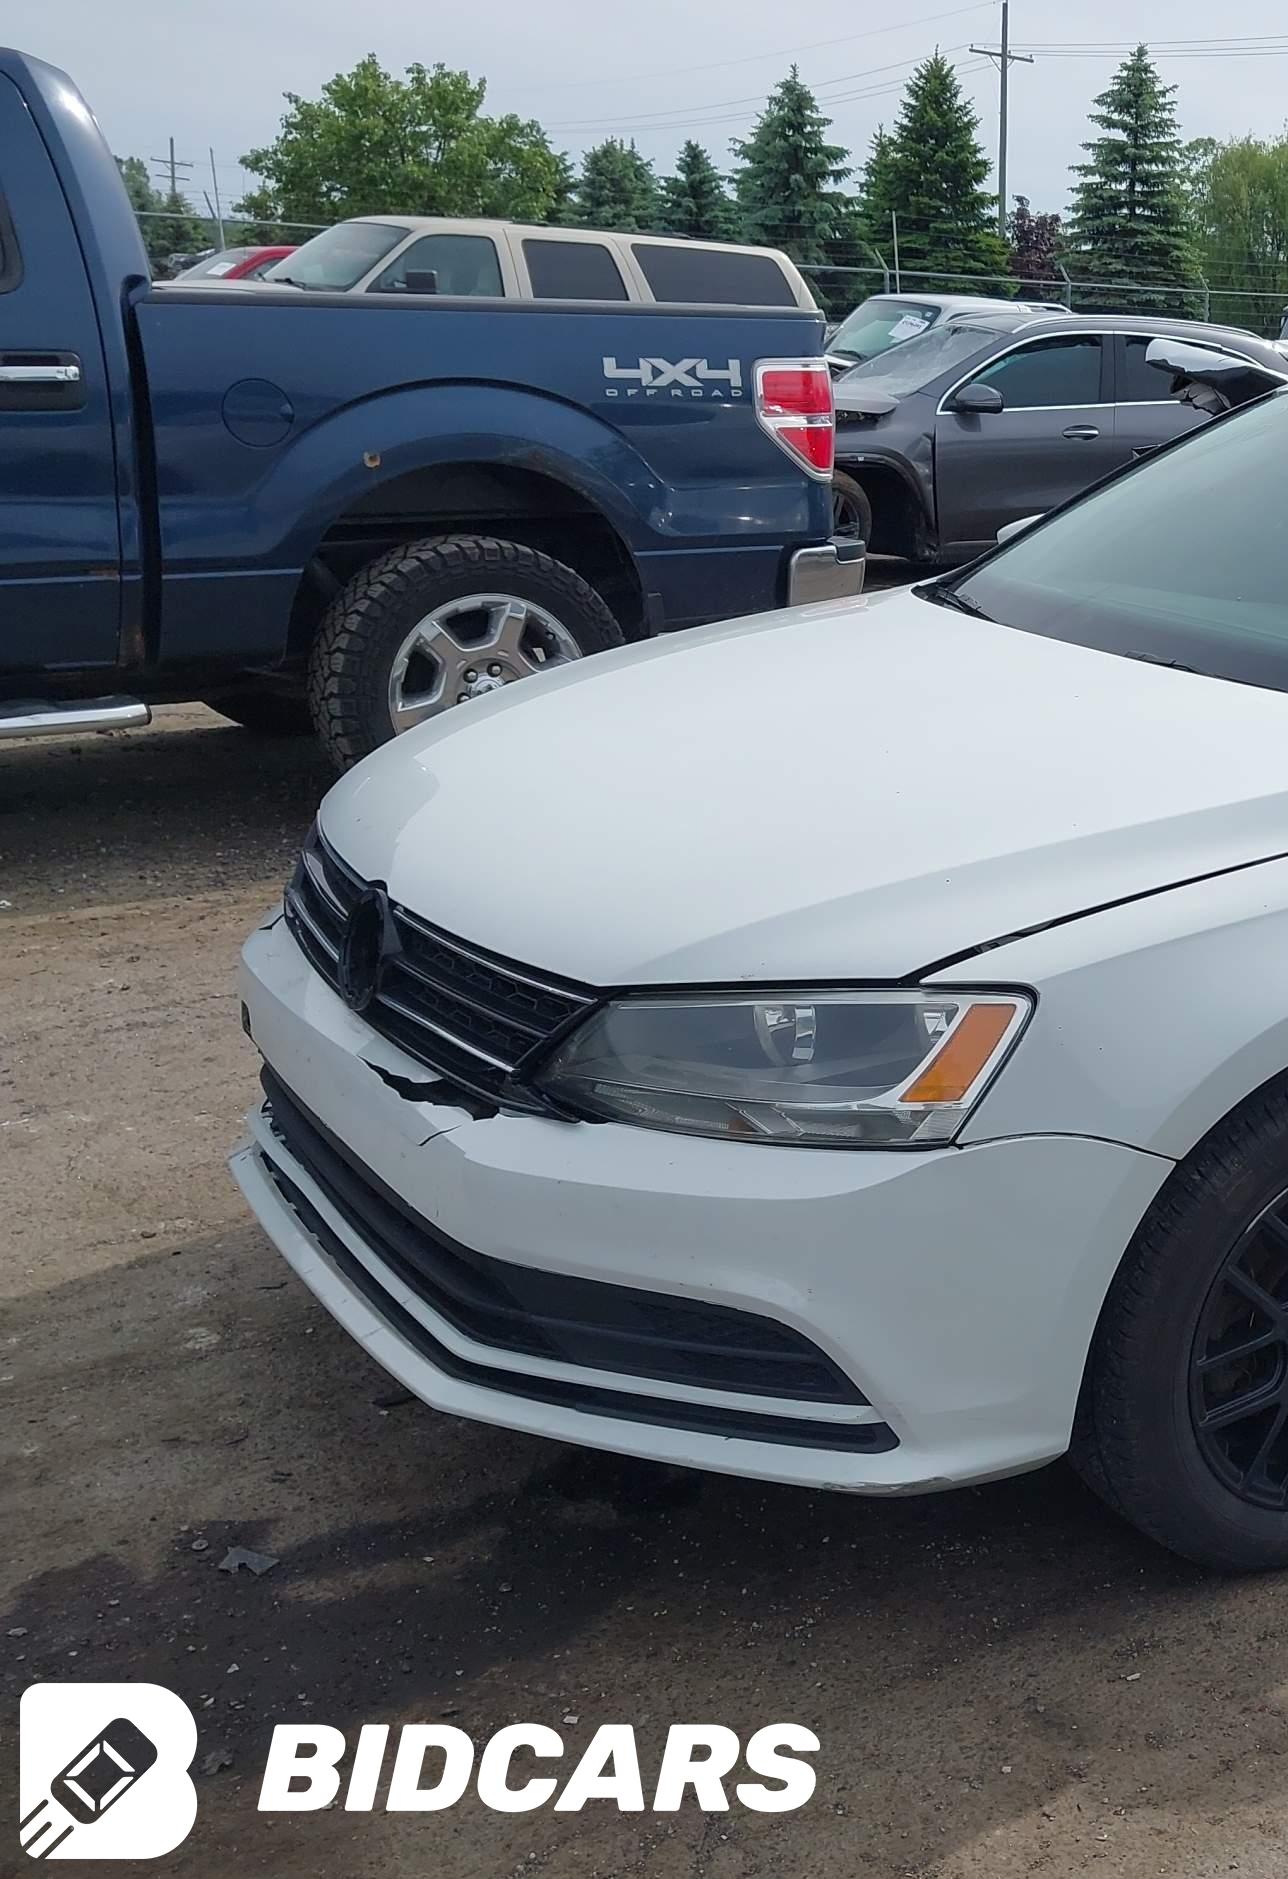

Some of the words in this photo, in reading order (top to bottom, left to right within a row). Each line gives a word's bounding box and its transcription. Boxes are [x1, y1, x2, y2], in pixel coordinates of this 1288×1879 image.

[602, 356, 742, 387] 4X4
[605, 388, 658, 397] OFF
[671, 388, 743, 397] ROAD
